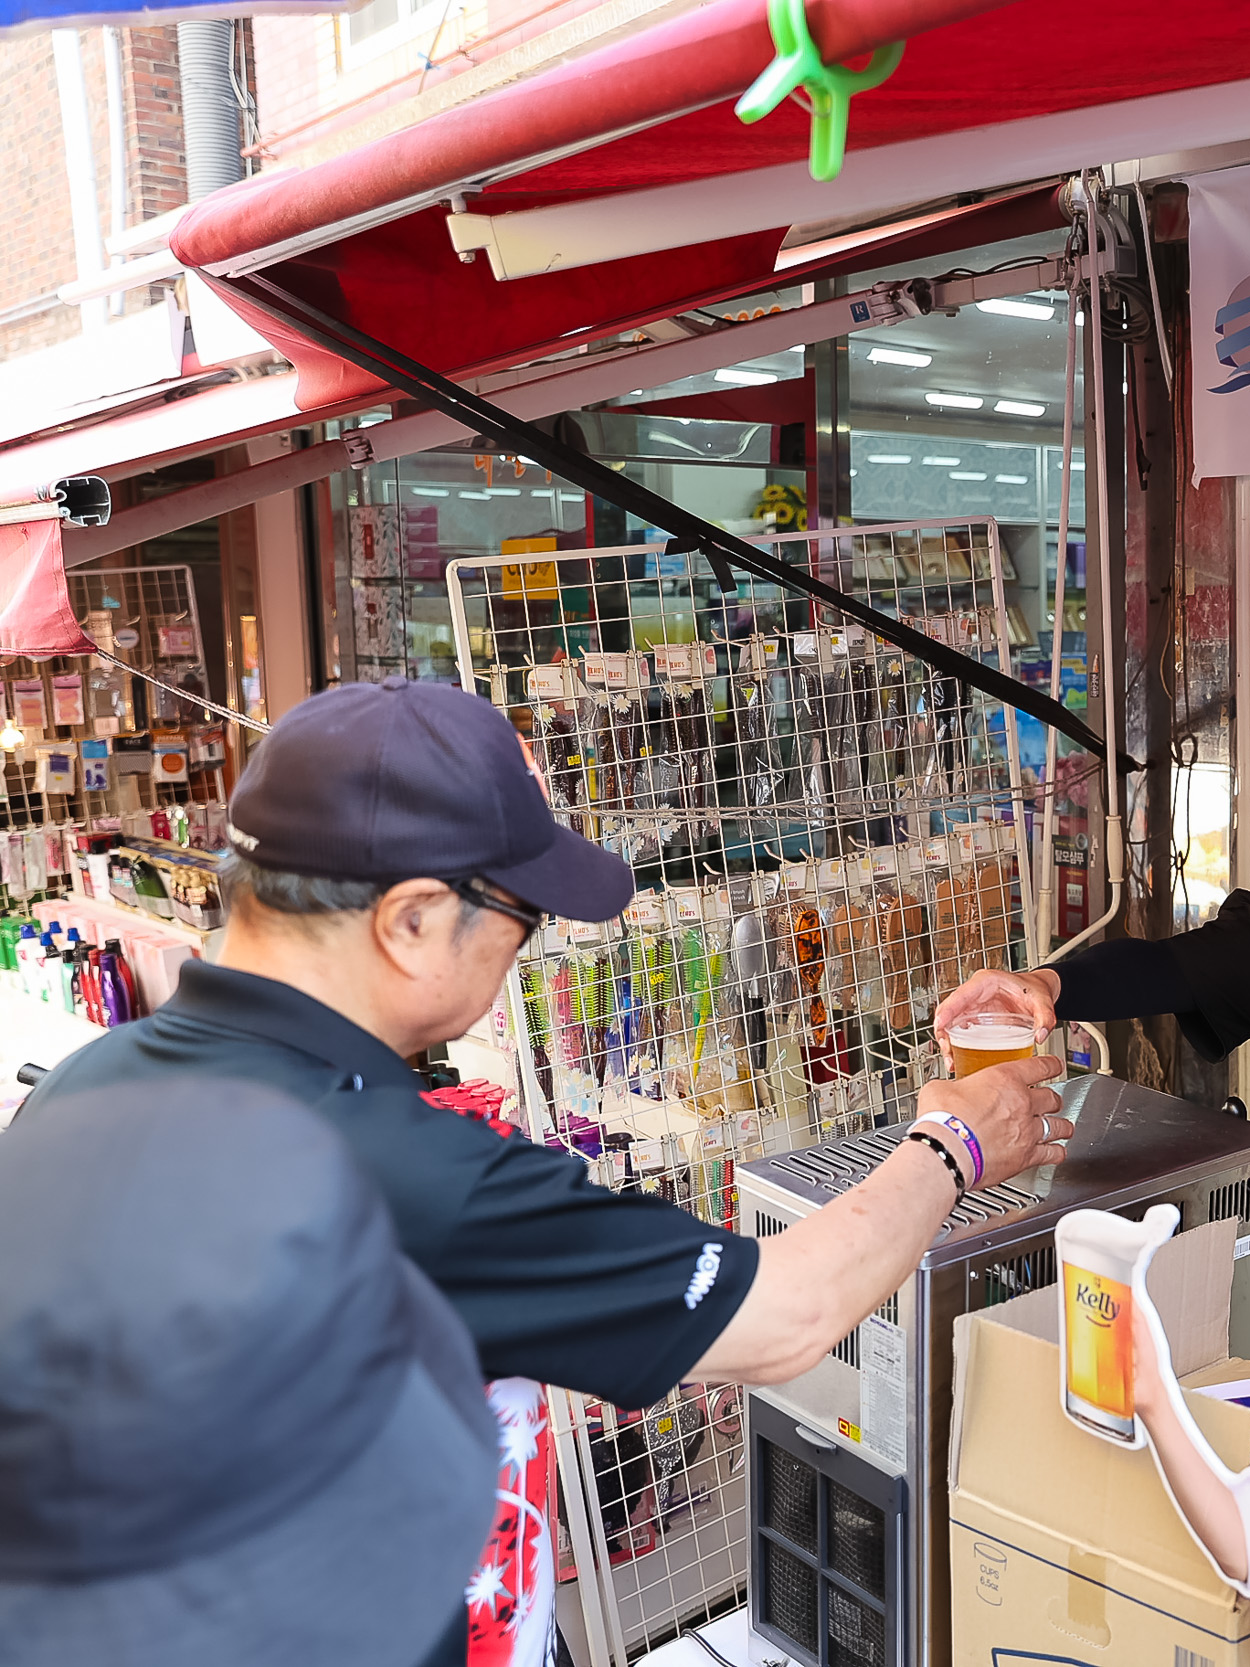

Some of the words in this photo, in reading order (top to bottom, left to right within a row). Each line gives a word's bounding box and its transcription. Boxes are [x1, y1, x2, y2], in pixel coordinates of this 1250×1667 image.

[1075, 1282, 1121, 1322] Kelly
[979, 1563, 1000, 1580] CUPS
[979, 1576, 1000, 1592] 6.5oz
